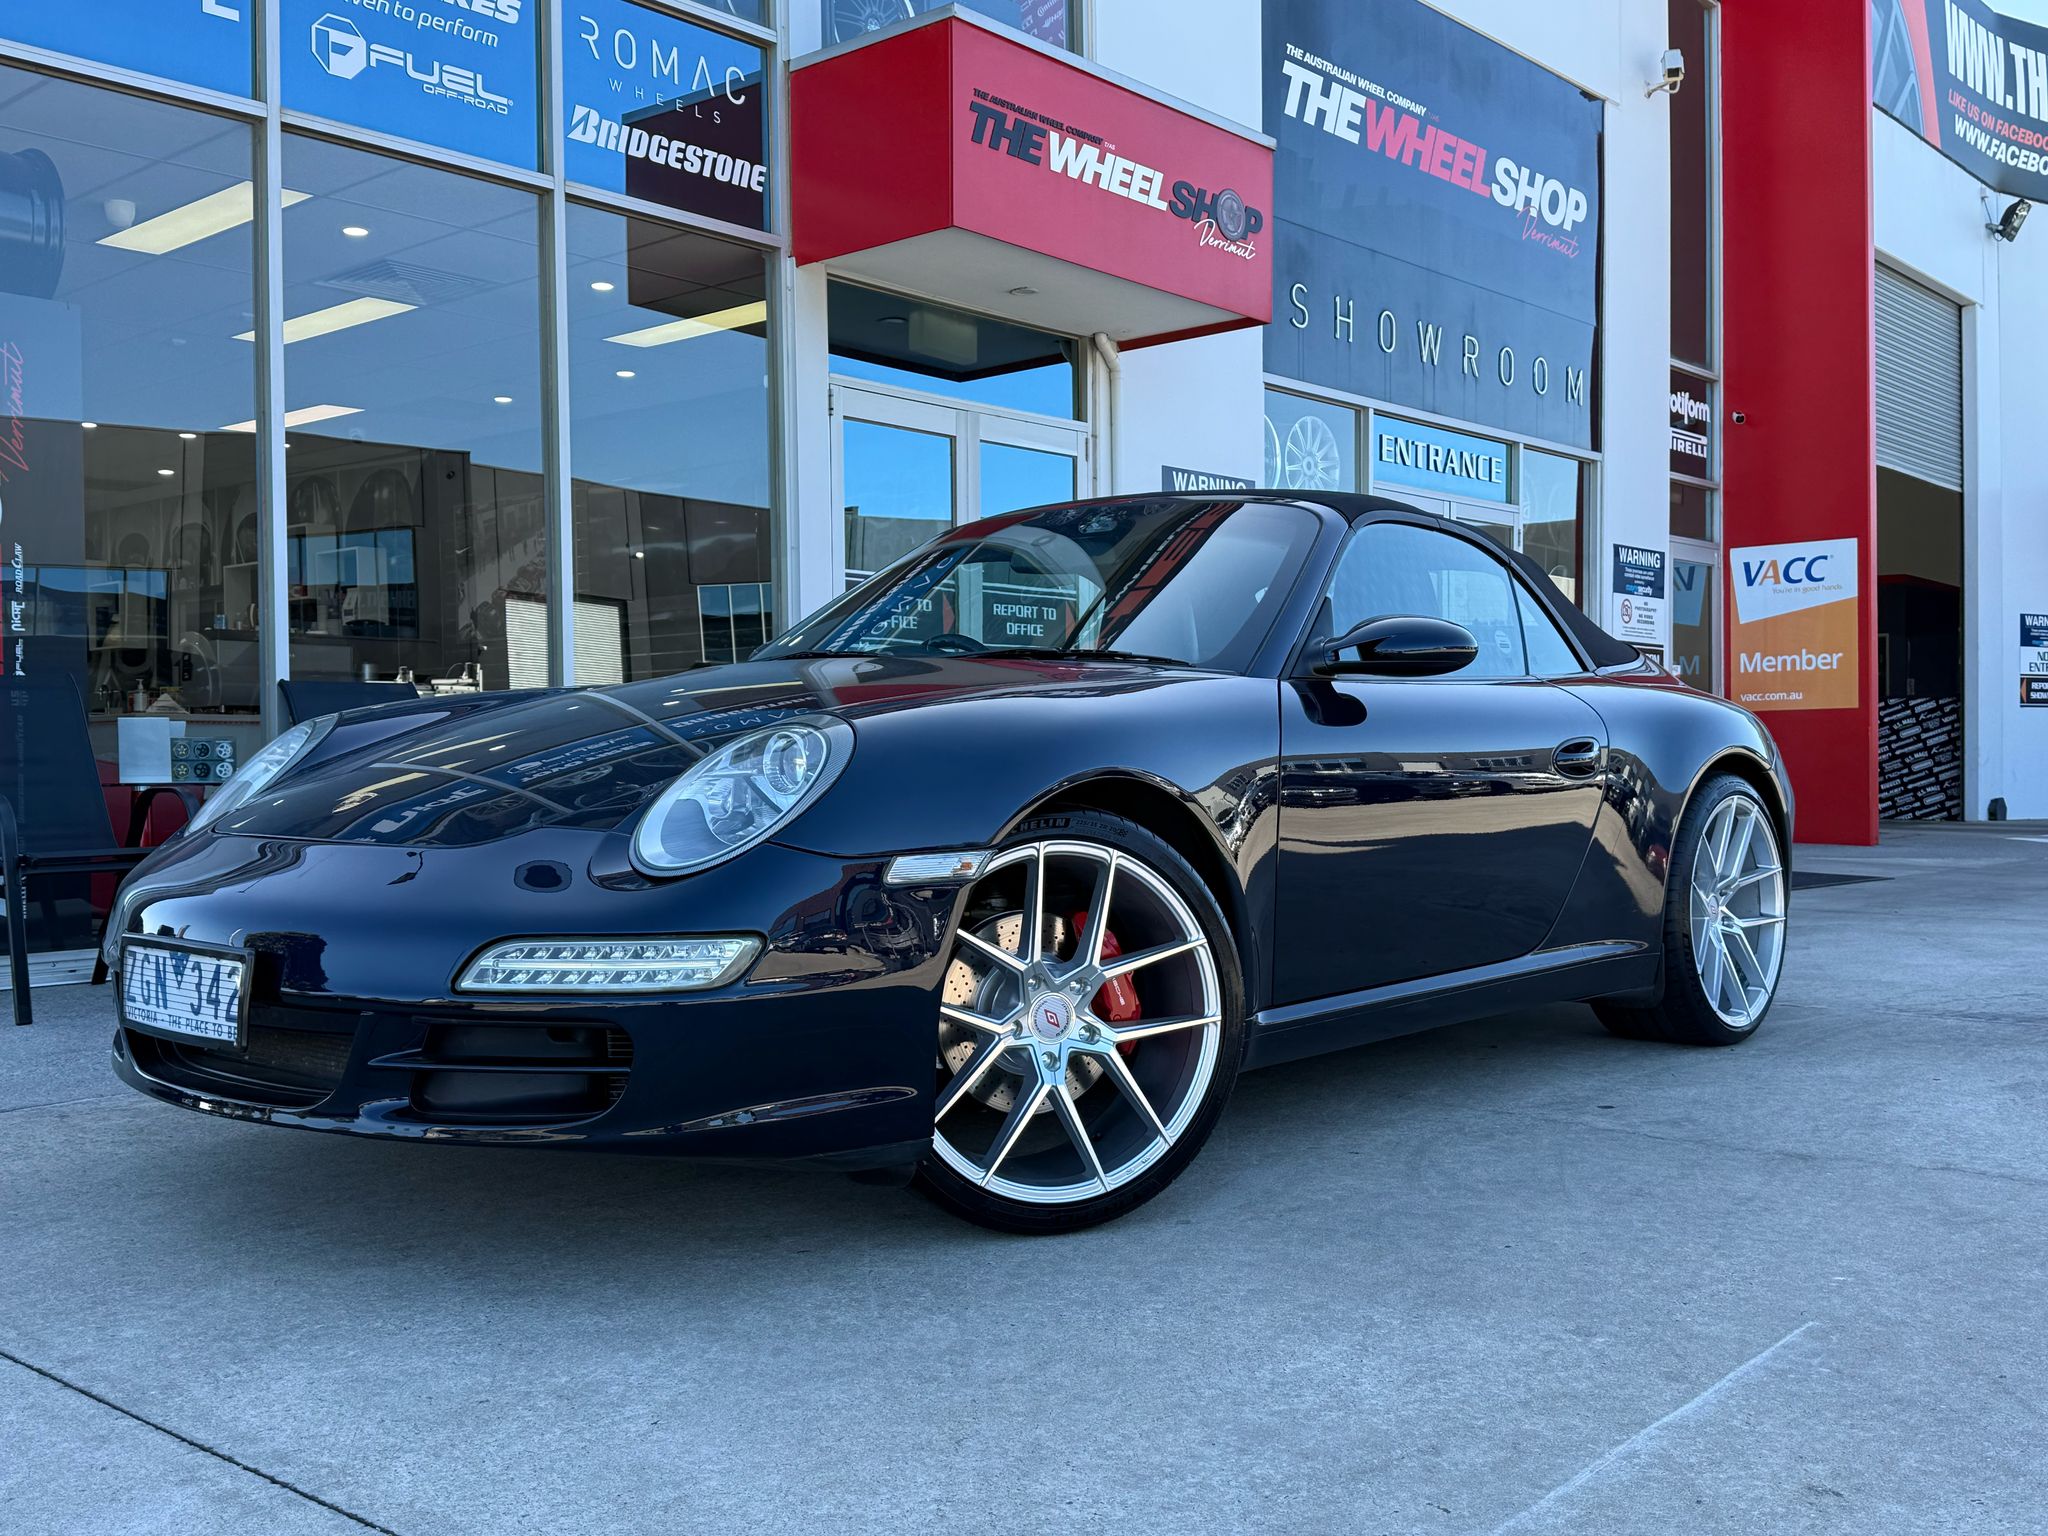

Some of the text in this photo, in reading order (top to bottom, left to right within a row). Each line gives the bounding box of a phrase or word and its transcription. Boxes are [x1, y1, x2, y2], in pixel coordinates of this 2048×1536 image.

[393, 1, 415, 22] to
[417, 12, 499, 48] perform
[369, 43, 508, 105] FUEL
[580, 15, 746, 105] ROMAC
[1285, 43, 1304, 61] THE
[1304, 52, 1357, 85] AUSTRALIAN
[1357, 76, 1386, 99] WHEEL
[1386, 90, 1427, 117] COMPANY
[423, 83, 508, 115] OFF-ROAD
[609, 78, 721, 124] WHEELS
[973, 87, 990, 101] THE
[989, 95, 1039, 121] AUSTRALIAN
[1039, 114, 1065, 132] WHEEL
[1066, 125, 1104, 146] COMPANY
[1948, 88, 1967, 113] LIKE
[1967, 103, 1980, 122] US
[1980, 111, 1995, 132] ON
[567, 104, 767, 193] BRIDGESTONE
[1282, 59, 1588, 233] THE WHEEL SHOP
[970, 99, 1264, 241] THE WHEEL SHOP
[1194, 218, 1256, 260] Derrimut
[1517, 206, 1580, 259] Derrimut
[1289, 283, 1584, 407] SHOWROOM
[1669, 391, 1711, 425] otiform
[1380, 433, 1504, 484] ENTRANCE
[1618, 546, 1661, 569] WARNING
[1743, 555, 1829, 587] VACC
[993, 603, 1057, 621] REPORT TO
[1772, 587, 1793, 595] You're
[1802, 585, 1821, 594] good
[1006, 622, 1044, 637] OFFICE
[1739, 648, 1843, 673] Member
[1740, 690, 1803, 702] vacc.com.au
[126, 951, 239, 1024] ZGN 342
[126, 1005, 158, 1024] VICTORIA
[168, 1014, 181, 1029] THE
[185, 1019, 209, 1035] PLACE
[212, 1023, 223, 1037] TO
